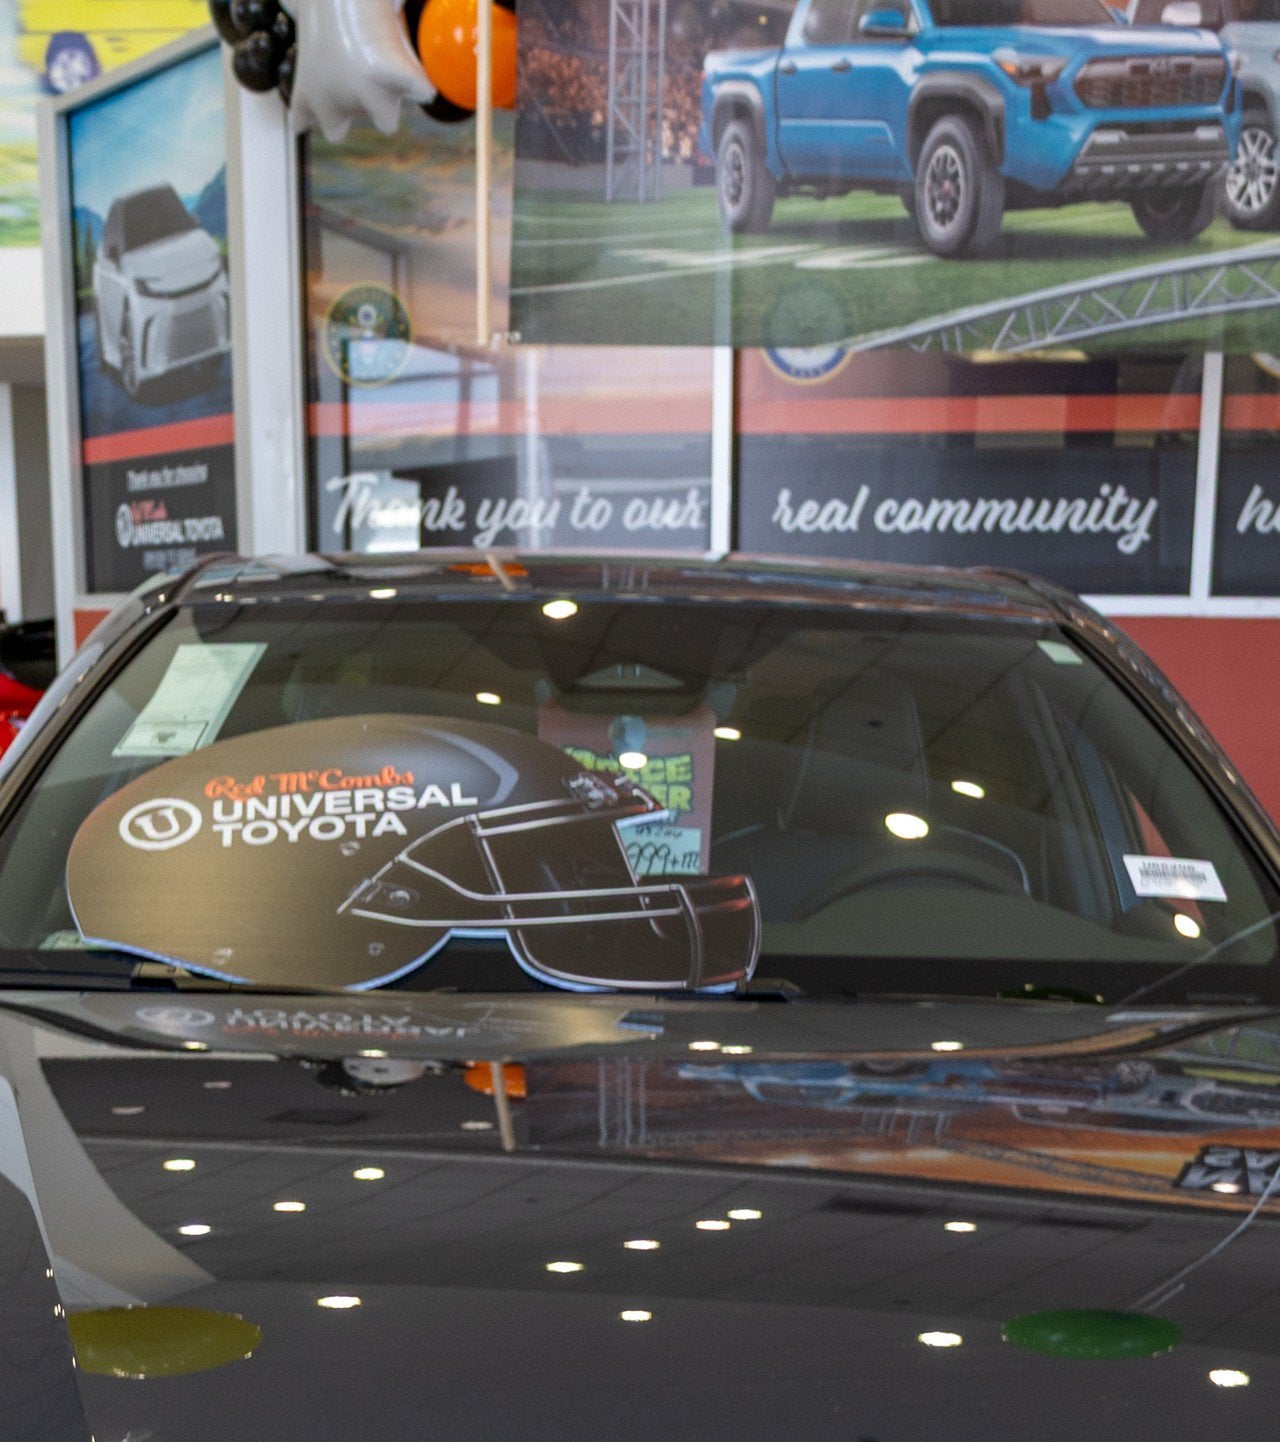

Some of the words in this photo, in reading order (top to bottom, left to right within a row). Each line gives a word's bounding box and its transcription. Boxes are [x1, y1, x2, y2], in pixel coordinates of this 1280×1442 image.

[326, 471, 468, 534] Thank
[473, 496, 561, 550] you
[569, 486, 614, 531] to
[621, 487, 706, 531] our
[772, 484, 870, 534] real
[873, 482, 1159, 555] community
[204, 774, 267, 803] Red
[269, 765, 415, 795] McCombs
[211, 782, 479, 824] UNIVERSAL
[211, 810, 409, 849] TOYOTA
